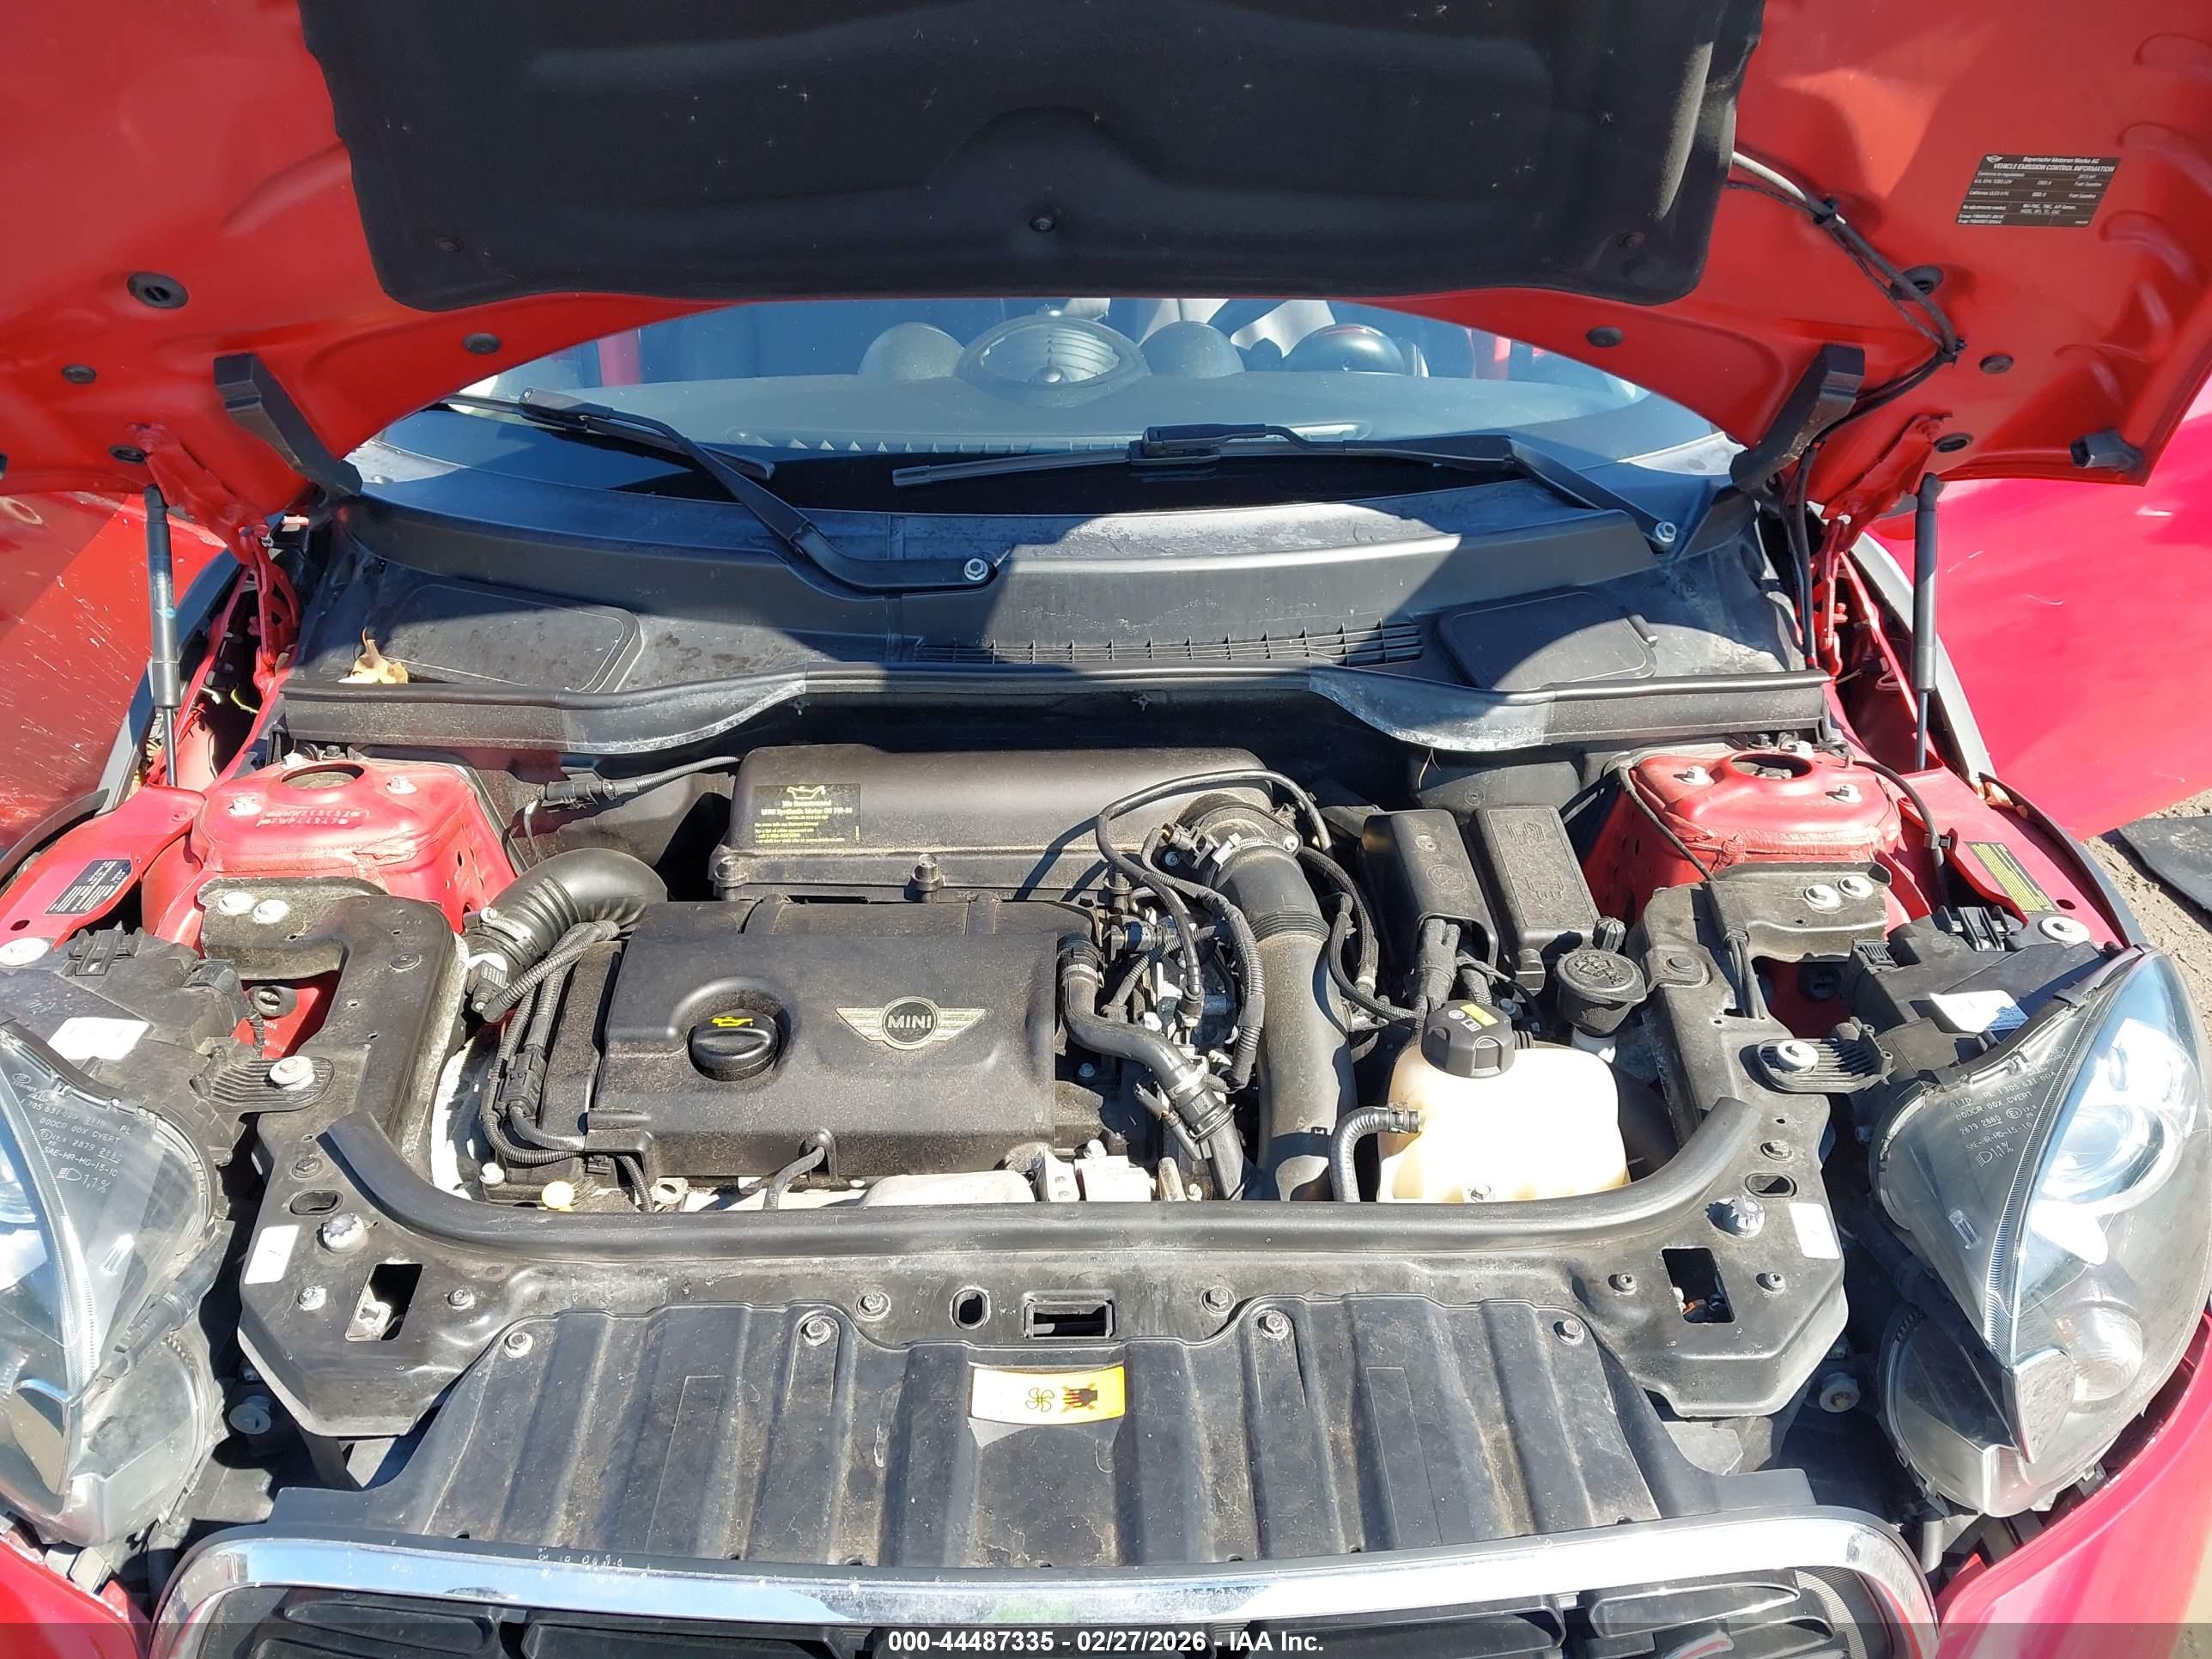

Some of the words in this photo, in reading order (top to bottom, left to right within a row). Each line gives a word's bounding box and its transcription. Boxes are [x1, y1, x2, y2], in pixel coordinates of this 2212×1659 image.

[2022, 155, 2051, 164] Bayerische
[777, 807, 804, 816] Synthetic
[887, 1015, 932, 1030] MINI
[119, 1125, 131, 1135] PL
